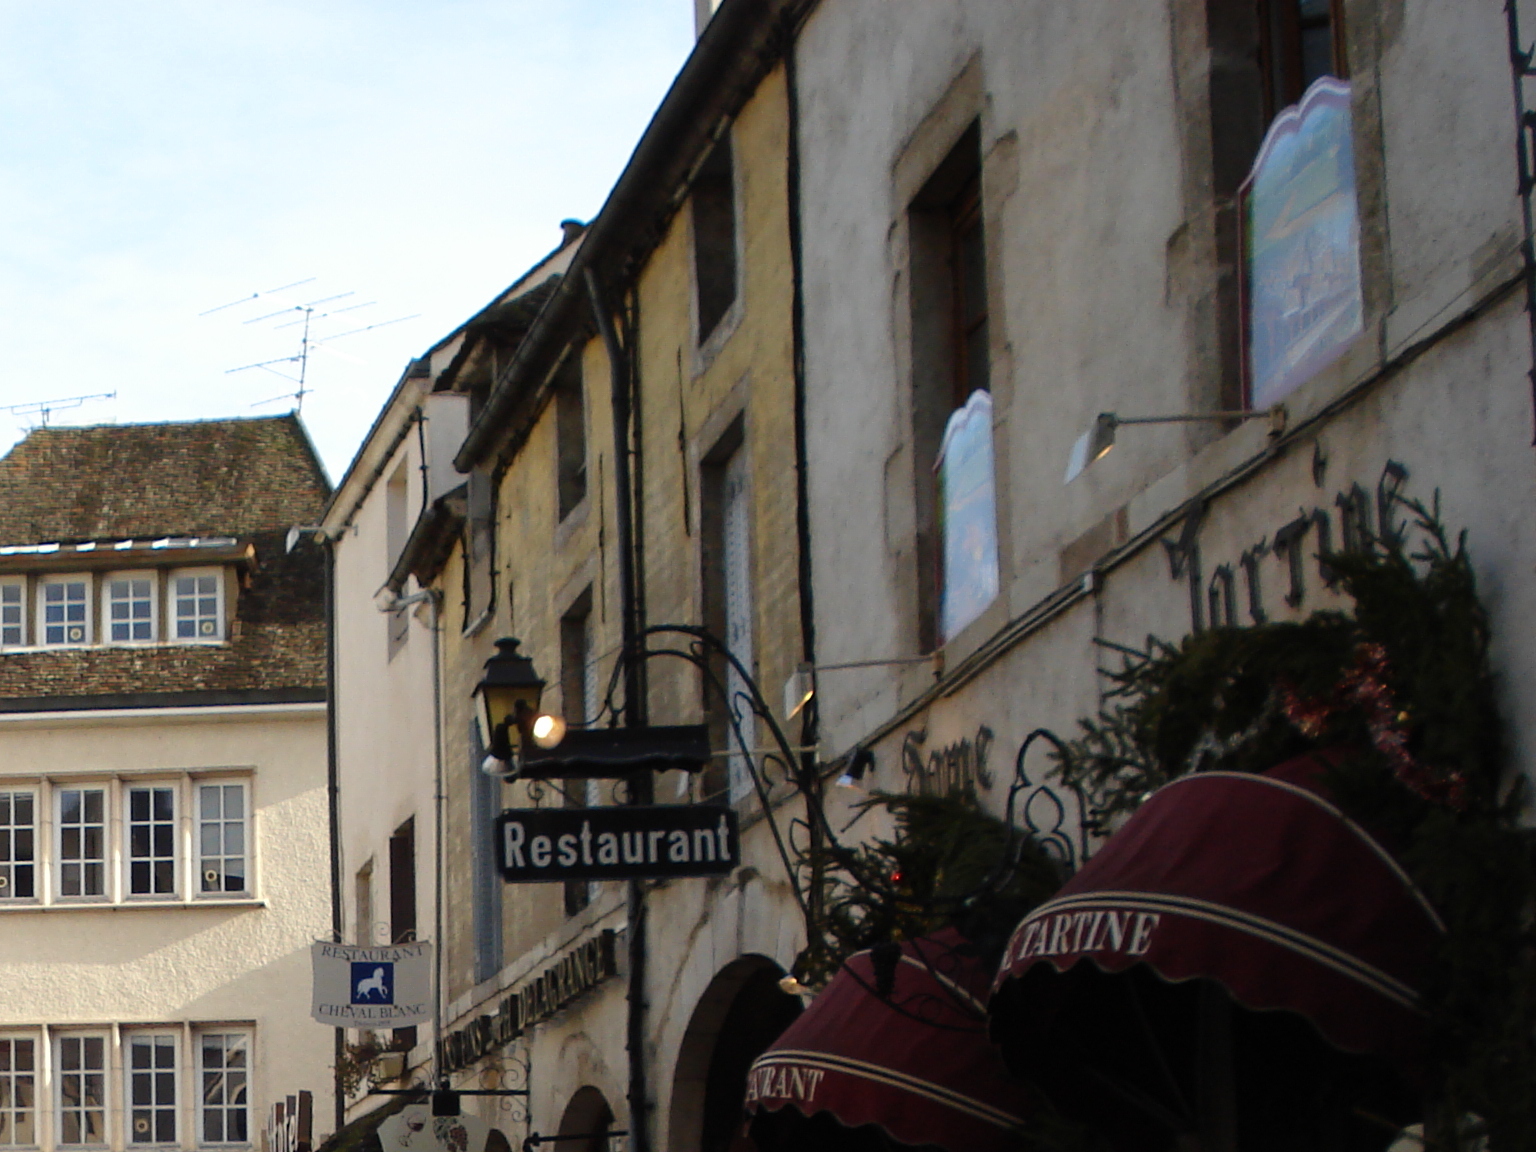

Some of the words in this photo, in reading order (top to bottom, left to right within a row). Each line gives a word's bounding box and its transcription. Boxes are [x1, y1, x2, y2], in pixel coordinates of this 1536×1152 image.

[503, 814, 731, 868] Restaurant
[1017, 910, 1161, 961] TARTINE
[322, 945, 423, 961] RESTAURANT
[319, 1004, 376, 1018] CHEVAL
[380, 1003, 427, 1018] BLANC
